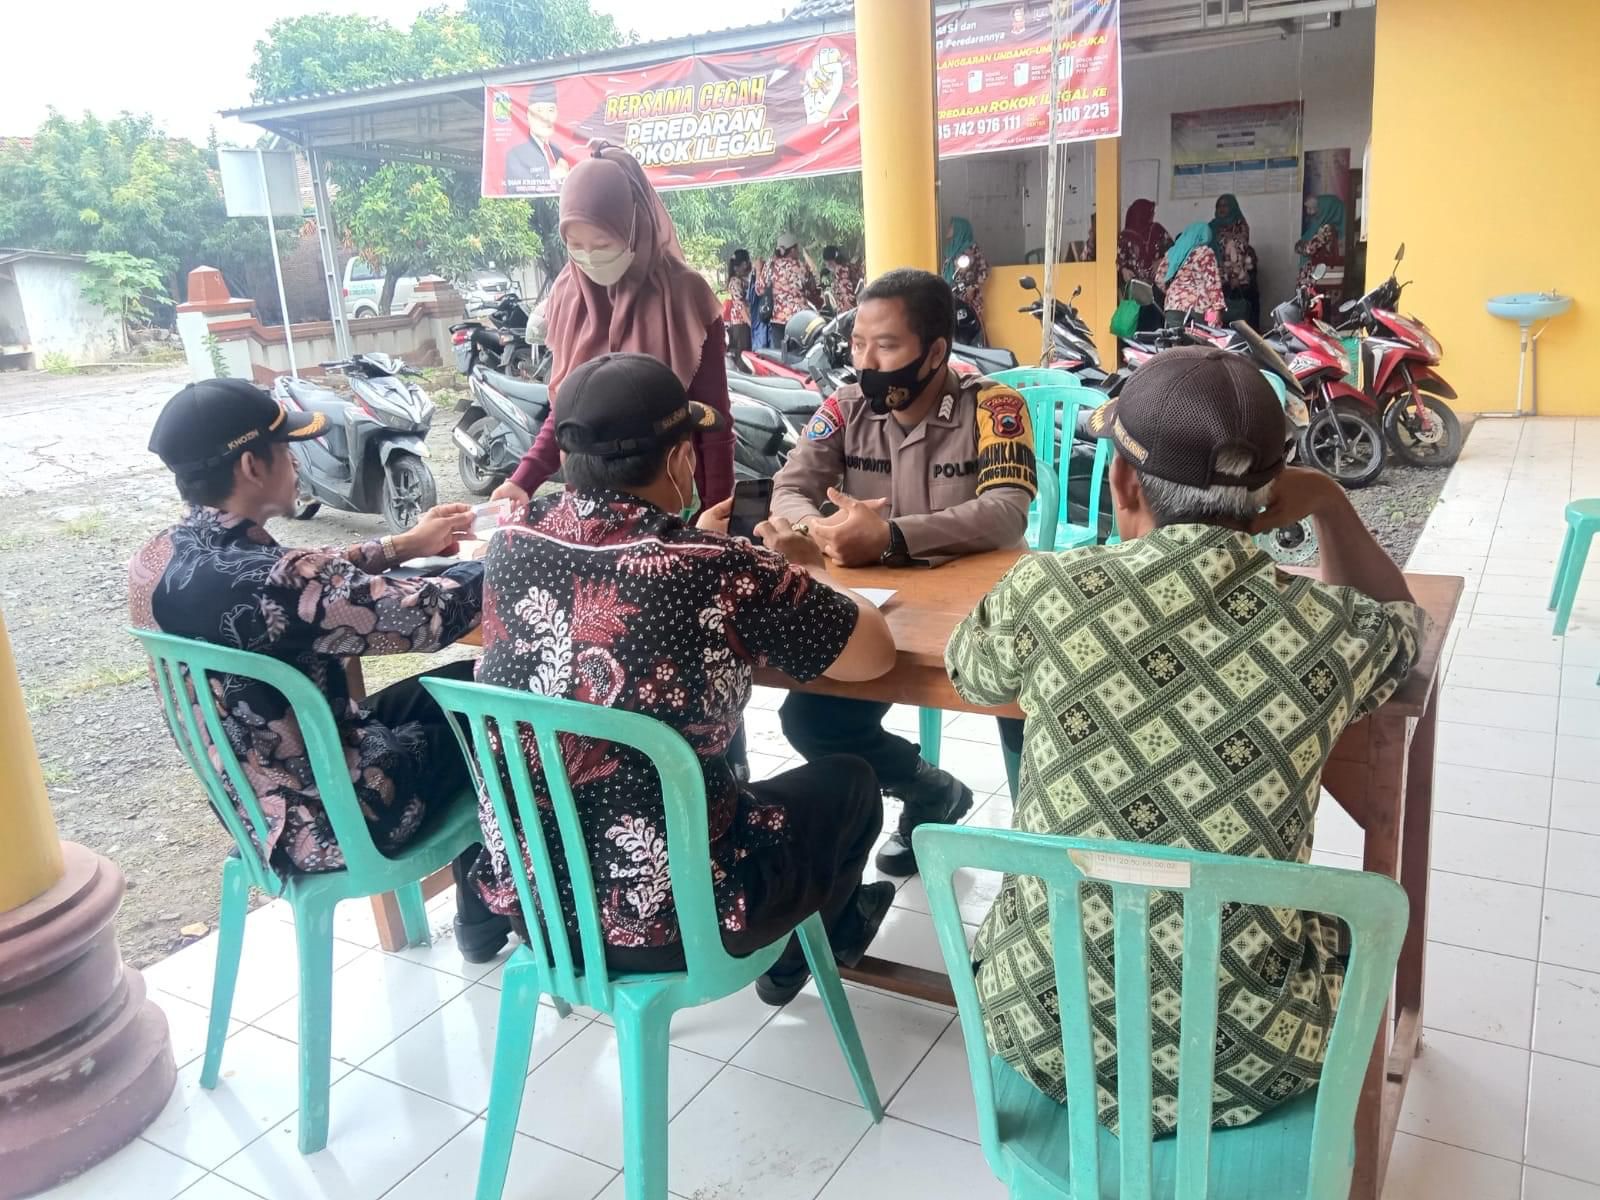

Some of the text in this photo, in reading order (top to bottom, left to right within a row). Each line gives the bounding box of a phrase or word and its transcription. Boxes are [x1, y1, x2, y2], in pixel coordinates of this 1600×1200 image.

[960, 21, 977, 31] dan
[945, 31, 1006, 48] Peredarannya
[937, 53, 992, 70] LANGGARAN
[605, 76, 766, 122] BERSAMA CEGAH
[989, 95, 1038, 113] ROKOK
[1092, 87, 1108, 97] KE
[1083, 102, 1110, 120] 225
[626, 108, 765, 145] PEREDARAN
[953, 120, 976, 137] 742
[976, 117, 1001, 135] 976
[1002, 115, 1021, 131] 111
[694, 131, 775, 161] ILEGAL
